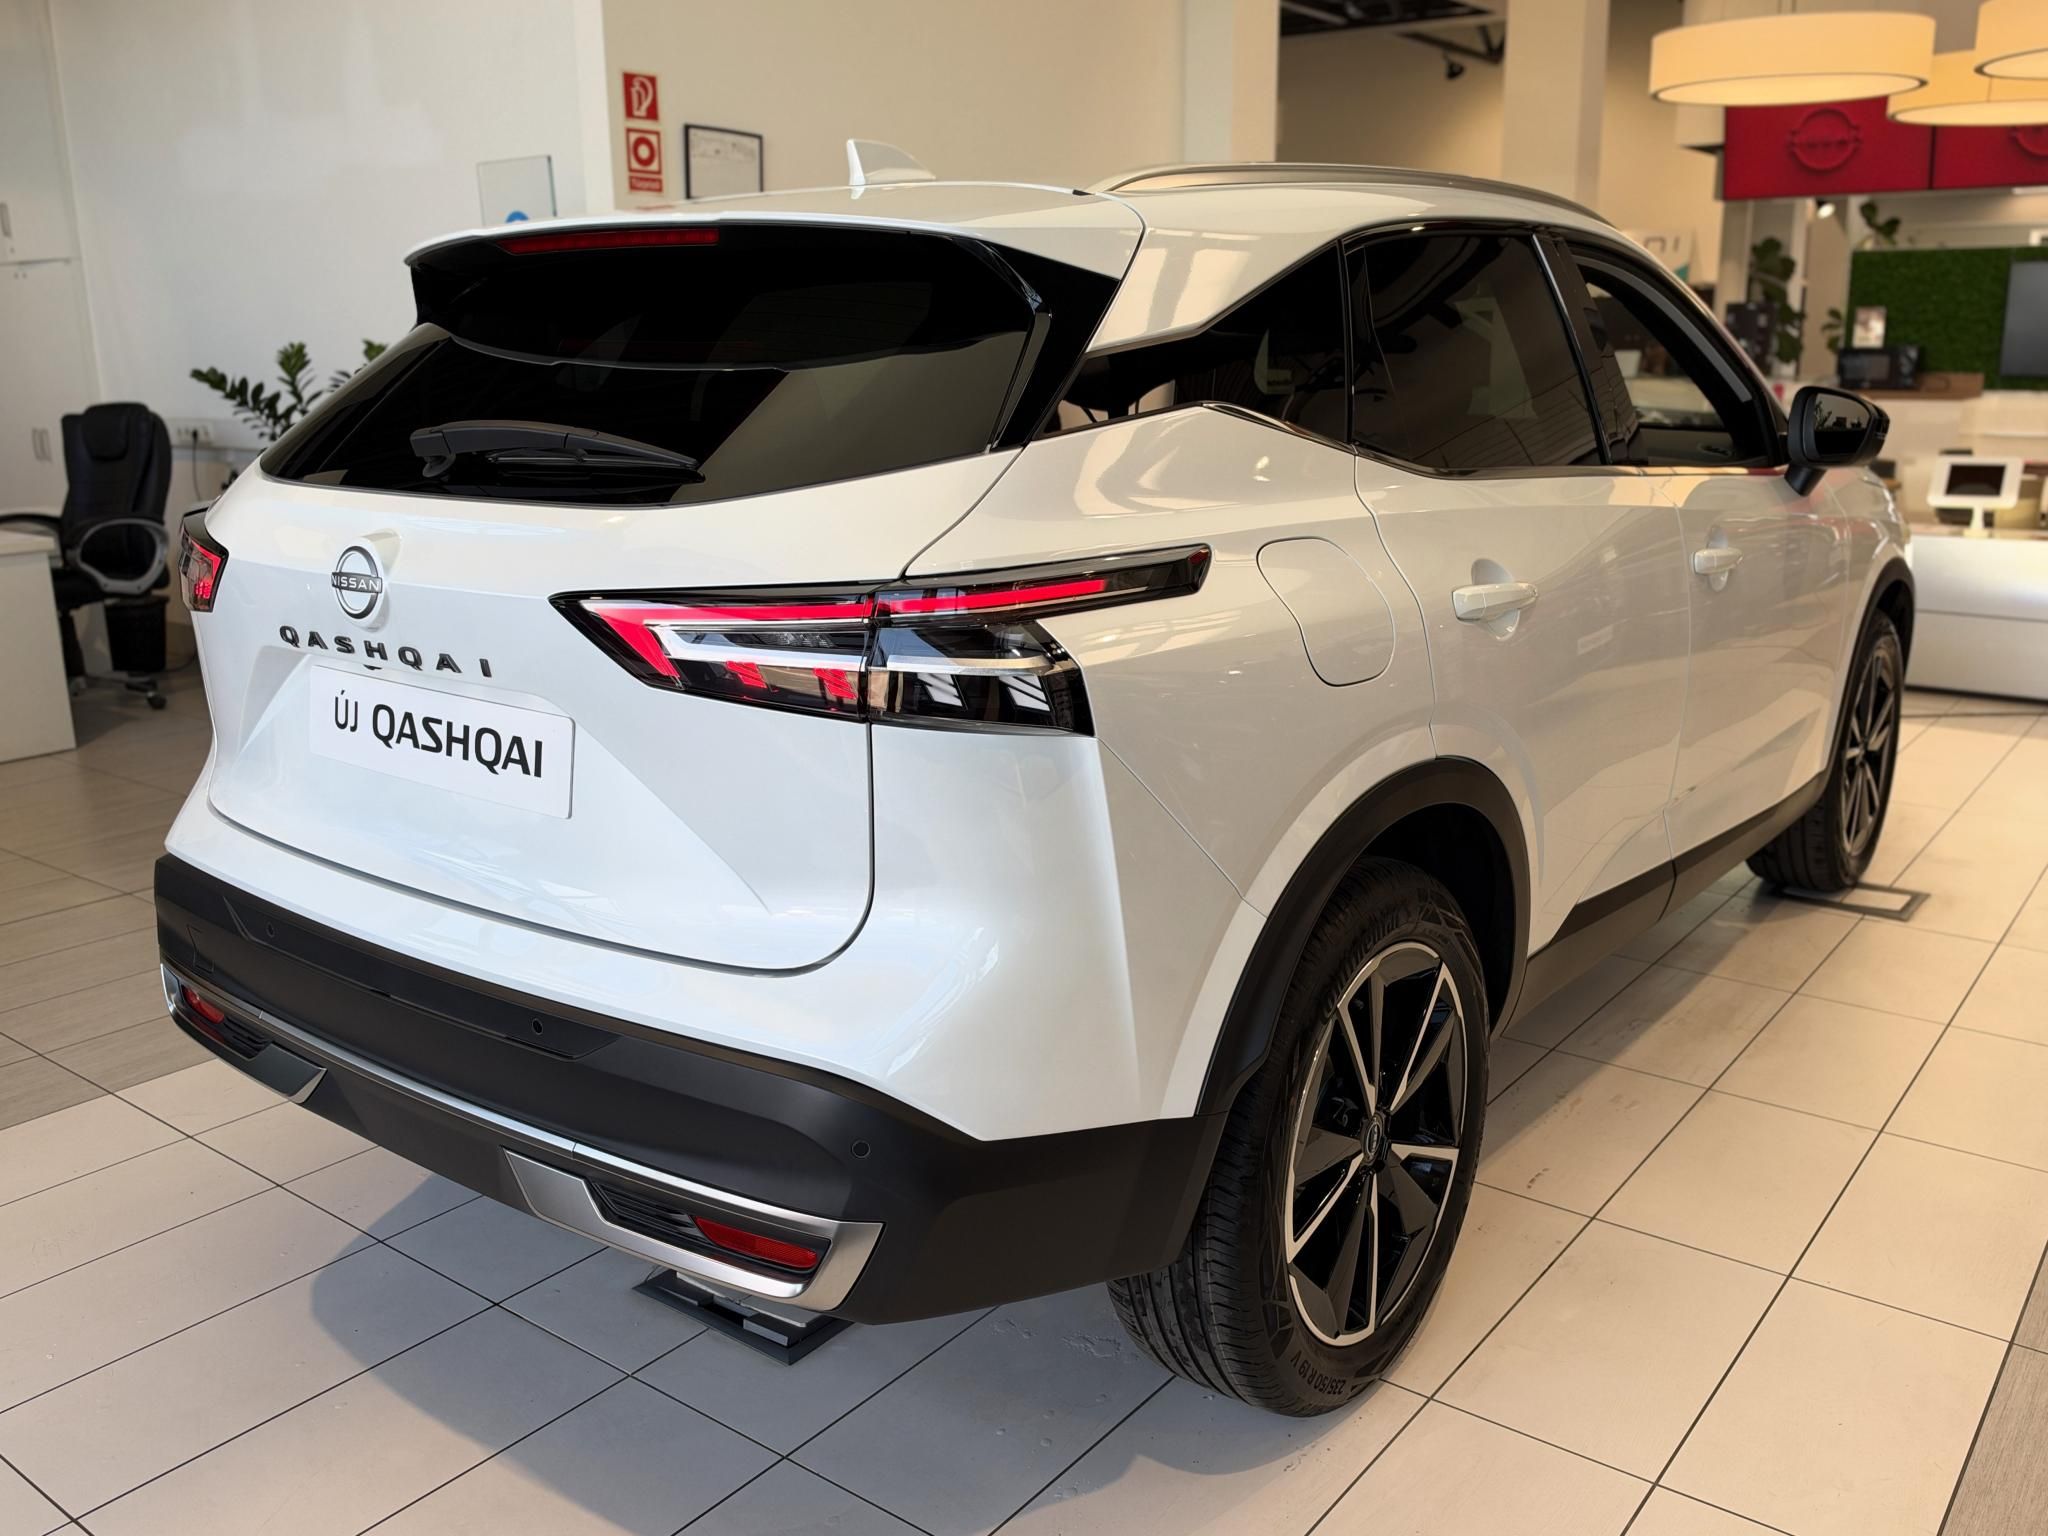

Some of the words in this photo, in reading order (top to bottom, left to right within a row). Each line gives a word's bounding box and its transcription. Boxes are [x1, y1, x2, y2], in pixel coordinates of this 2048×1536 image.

[331, 574, 379, 591] NISSAN
[279, 625, 493, 678] QASHQAI
[334, 690, 359, 733] ÚJ
[372, 704, 543, 778] QASHQAI
[1298, 1359, 1311, 1378] 19
[1313, 1374, 1346, 1395] 235/50
